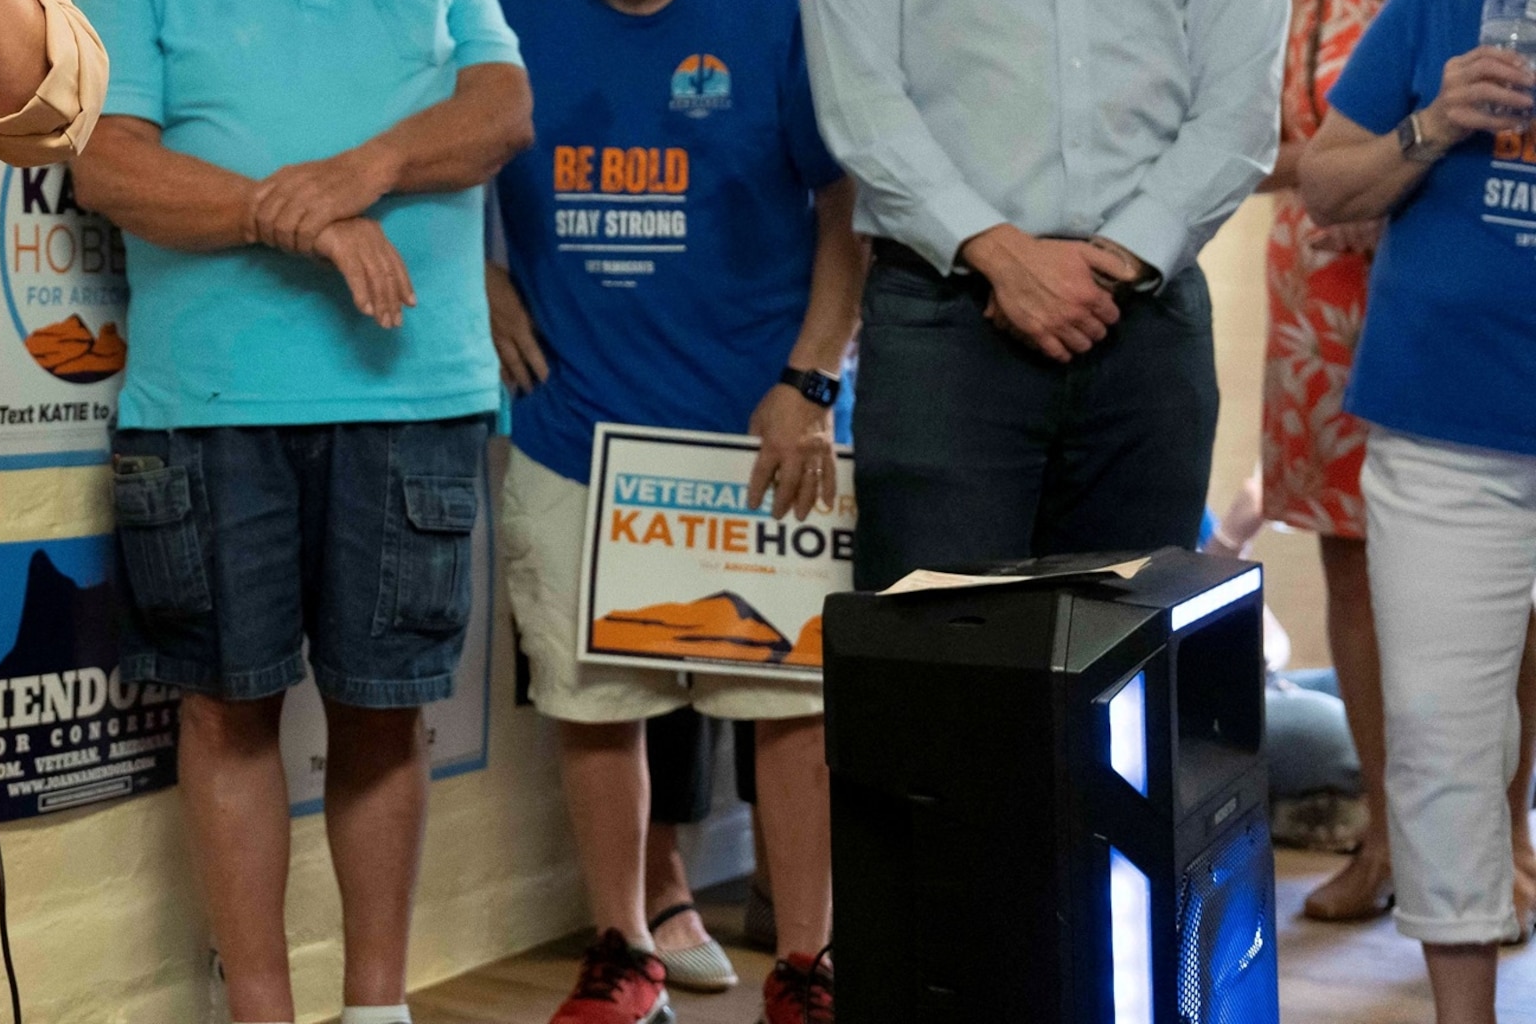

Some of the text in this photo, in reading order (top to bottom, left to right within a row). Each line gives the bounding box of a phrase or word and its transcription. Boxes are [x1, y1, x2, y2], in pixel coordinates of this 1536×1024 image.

[554, 145, 690, 194] BE BOLD
[554, 209, 687, 238] STAY STRONG
[14, 223, 126, 275] HOBB
[26, 286, 62, 307] FOR
[38, 402, 89, 424] KATIE
[93, 402, 110, 422] to
[615, 475, 773, 512] VETERA
[610, 508, 855, 561] KATIE HOB
[50, 709, 171, 748] CONGRES
